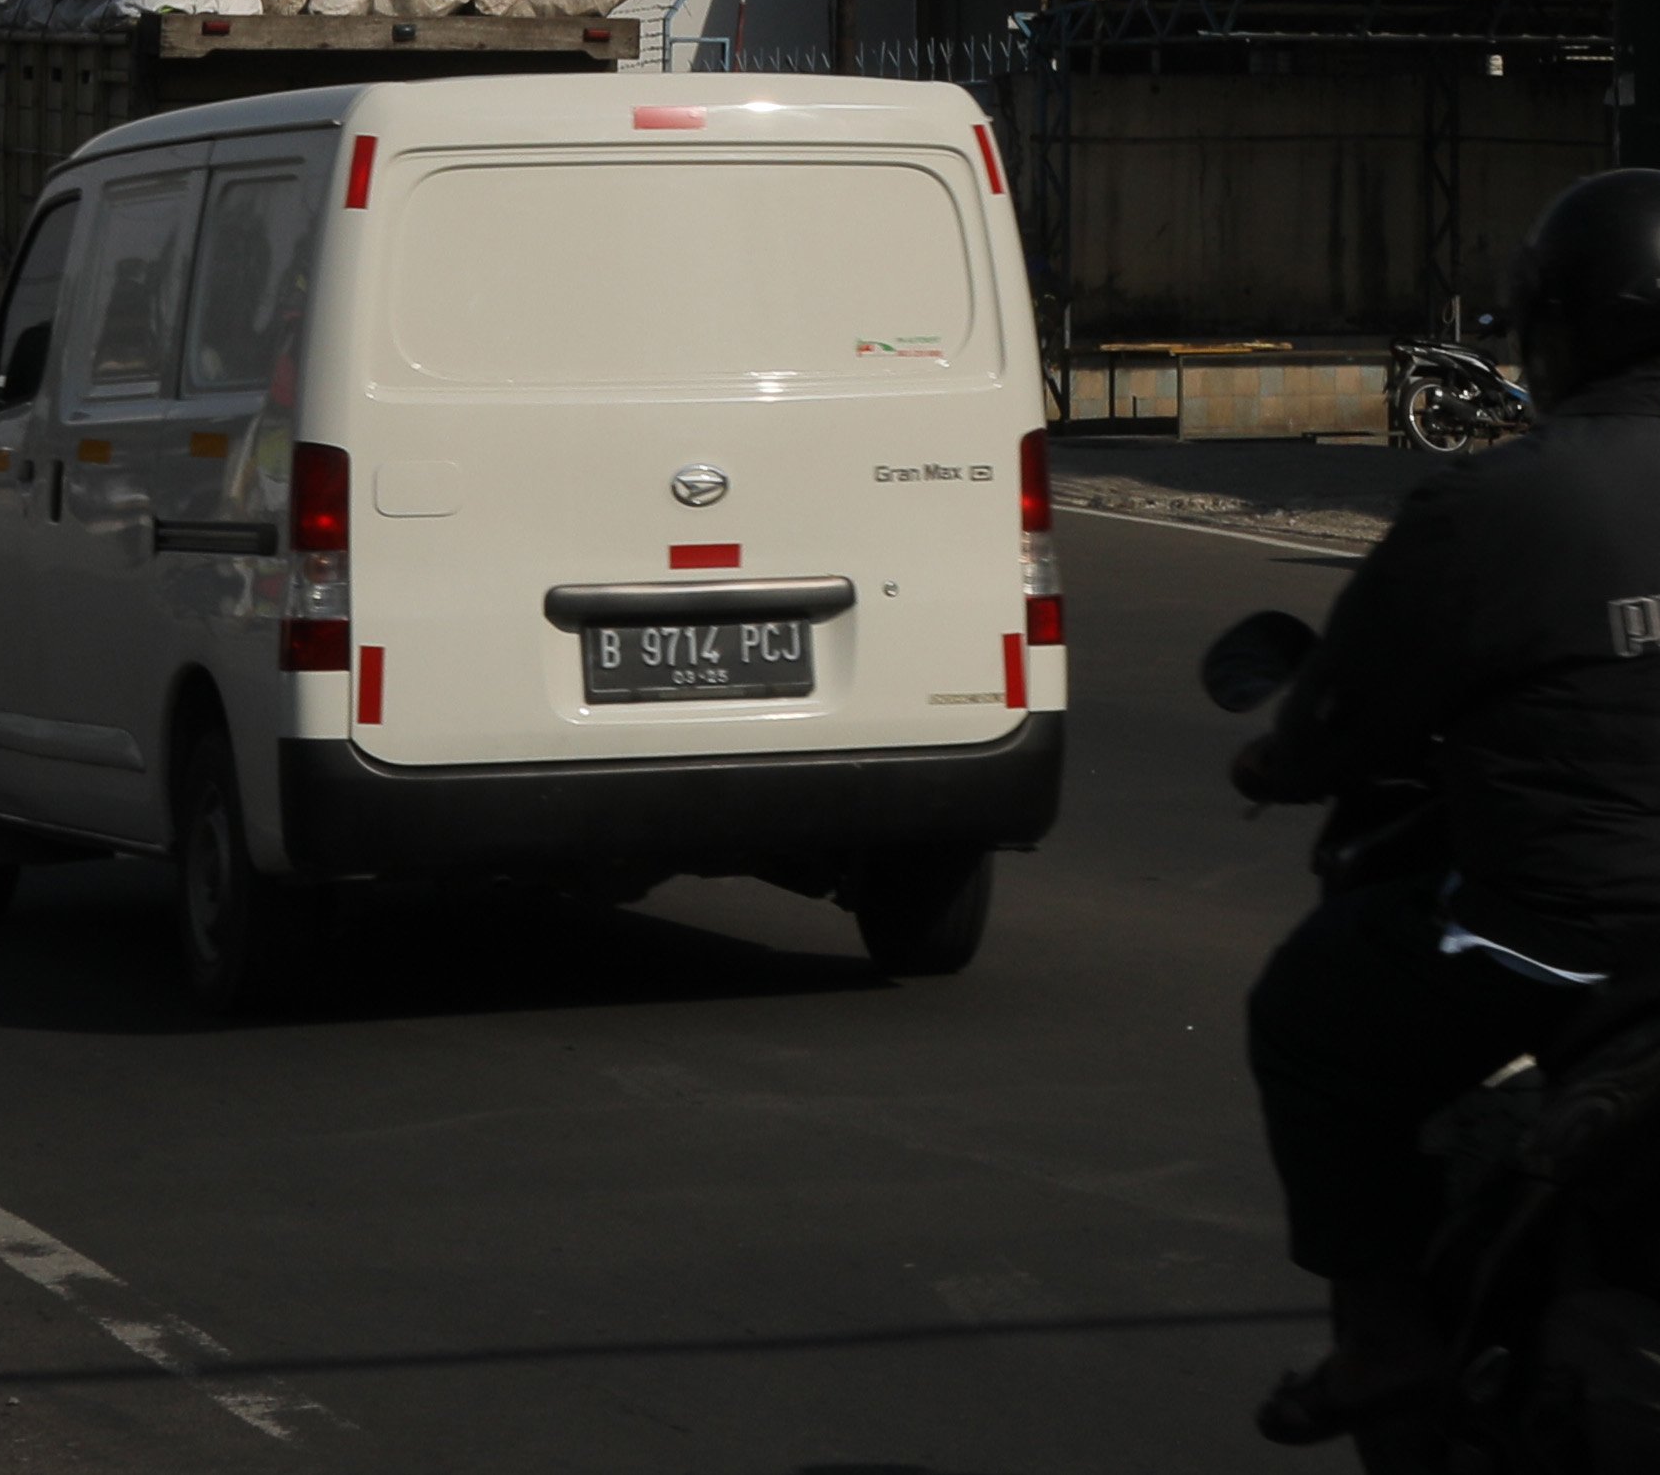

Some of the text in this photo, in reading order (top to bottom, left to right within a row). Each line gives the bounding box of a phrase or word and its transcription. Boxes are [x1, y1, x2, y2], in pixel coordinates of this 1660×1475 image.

[874, 465, 921, 482] Gran
[923, 464, 964, 481] Max
[600, 623, 802, 669] B 9714 PCJ
